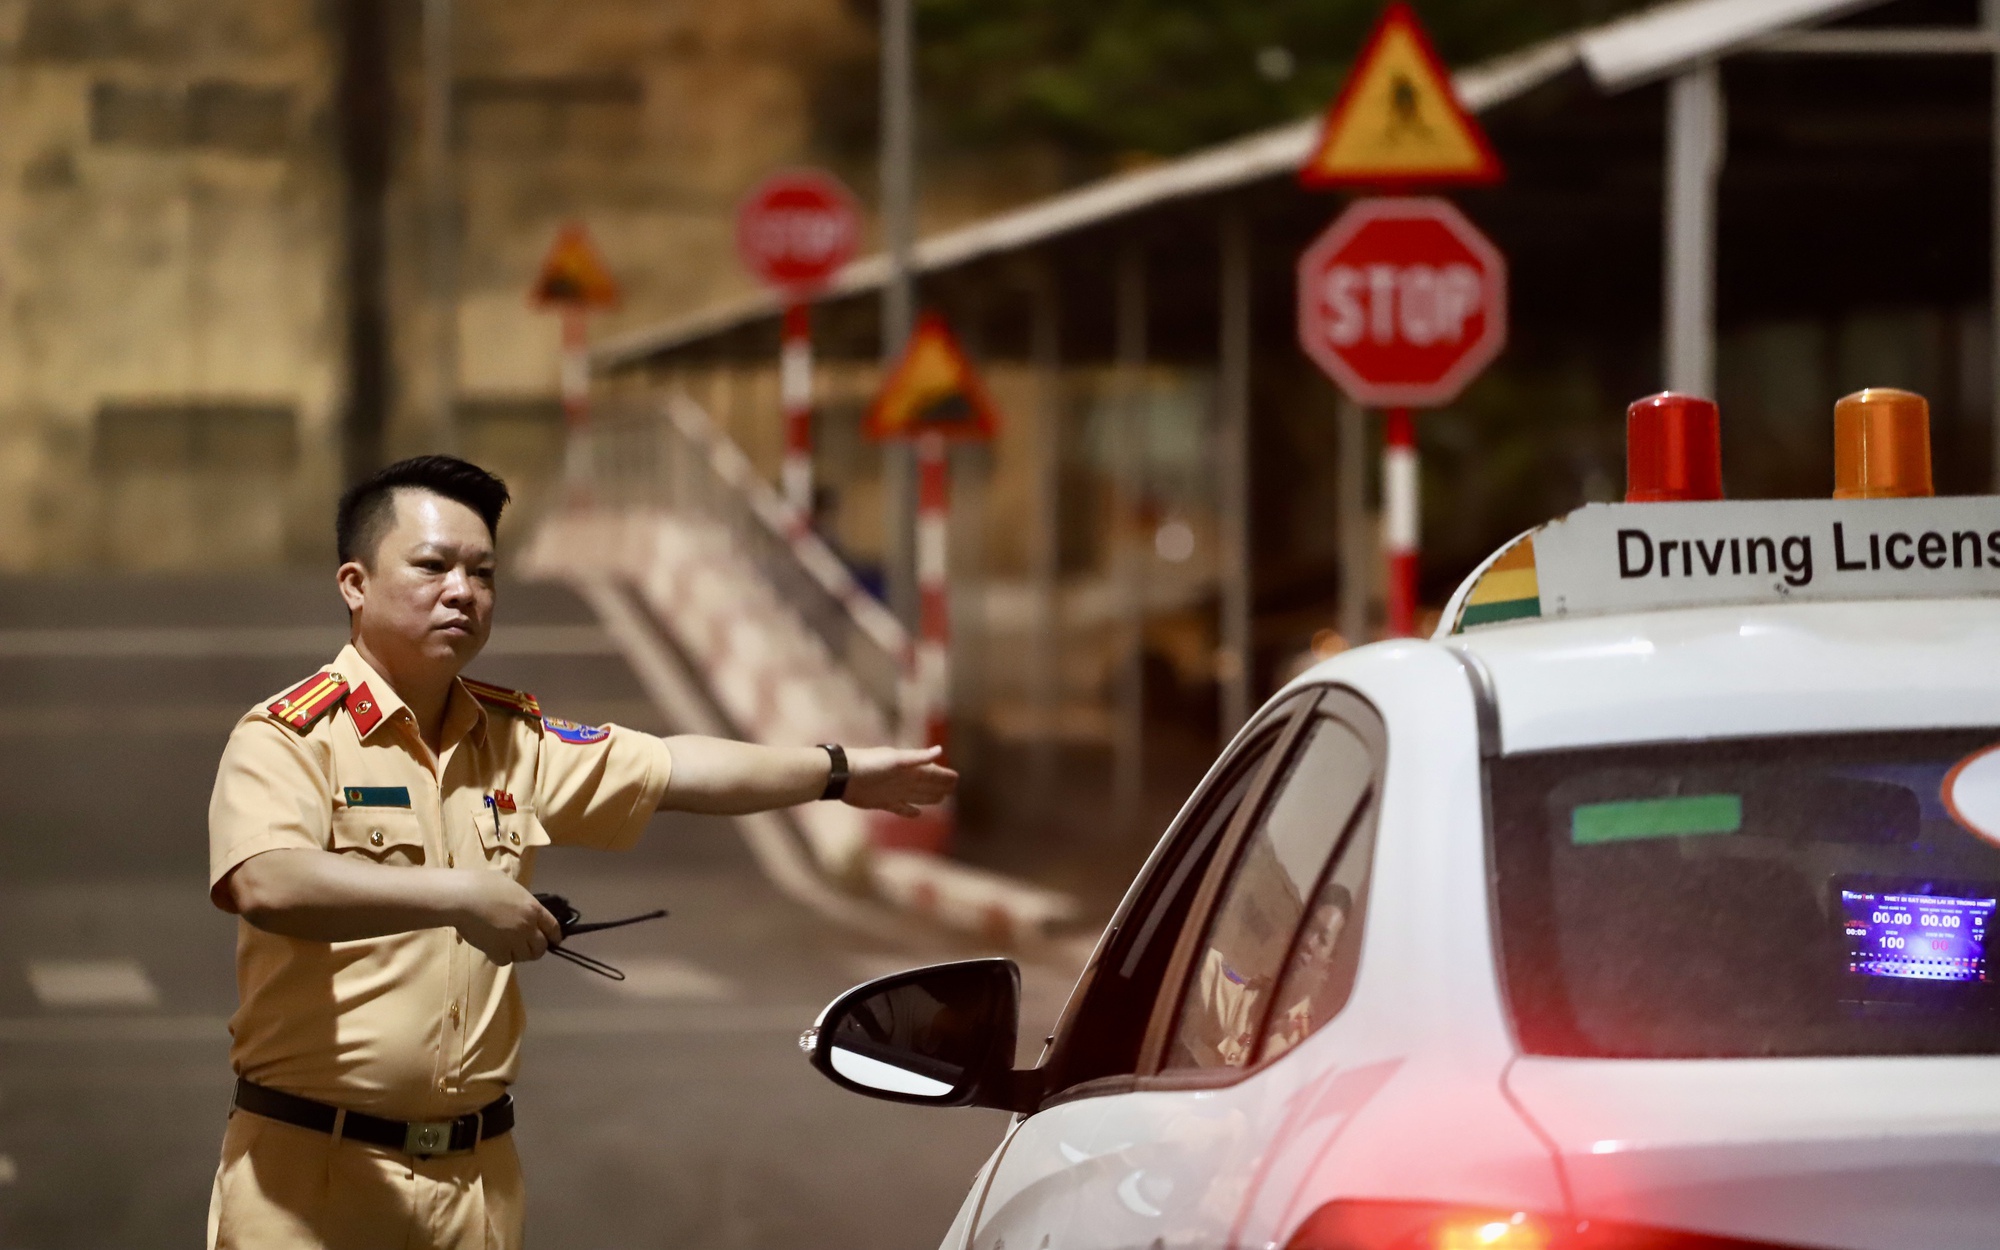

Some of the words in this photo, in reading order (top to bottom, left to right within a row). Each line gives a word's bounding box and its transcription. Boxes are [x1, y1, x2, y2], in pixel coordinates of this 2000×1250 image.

[1322, 263, 1481, 344] STOP
[1616, 528, 1813, 587] Driving
[1872, 911, 1912, 925] 00.00
[1920, 914, 1960, 928] 00.00
[1845, 928, 1867, 936] 00:00
[1879, 936, 1905, 949] 100
[1931, 940, 1949, 951] 00
